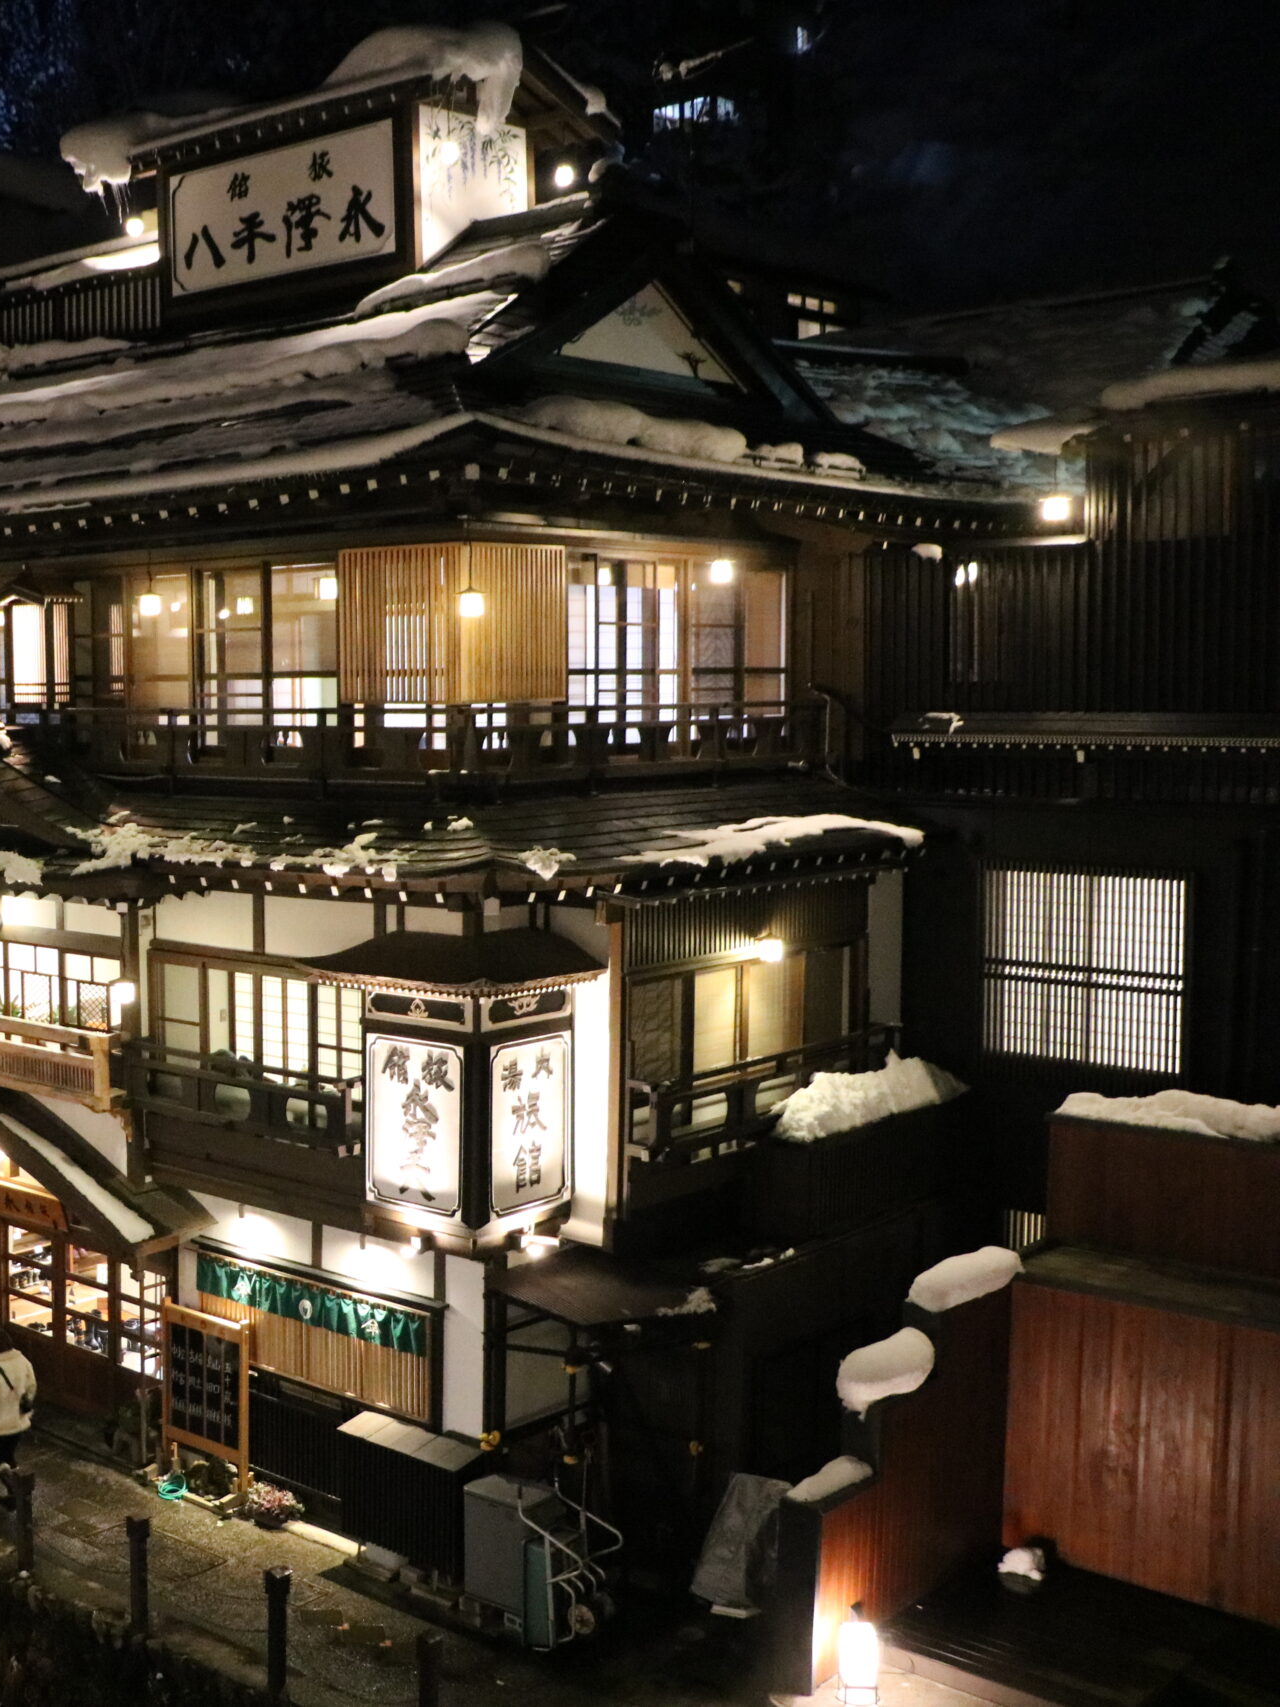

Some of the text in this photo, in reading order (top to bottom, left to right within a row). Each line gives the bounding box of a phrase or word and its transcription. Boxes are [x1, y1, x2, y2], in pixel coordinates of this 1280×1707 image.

[183, 184, 387, 270] 永澤平八
[511, 1091, 548, 1194] 旅館
